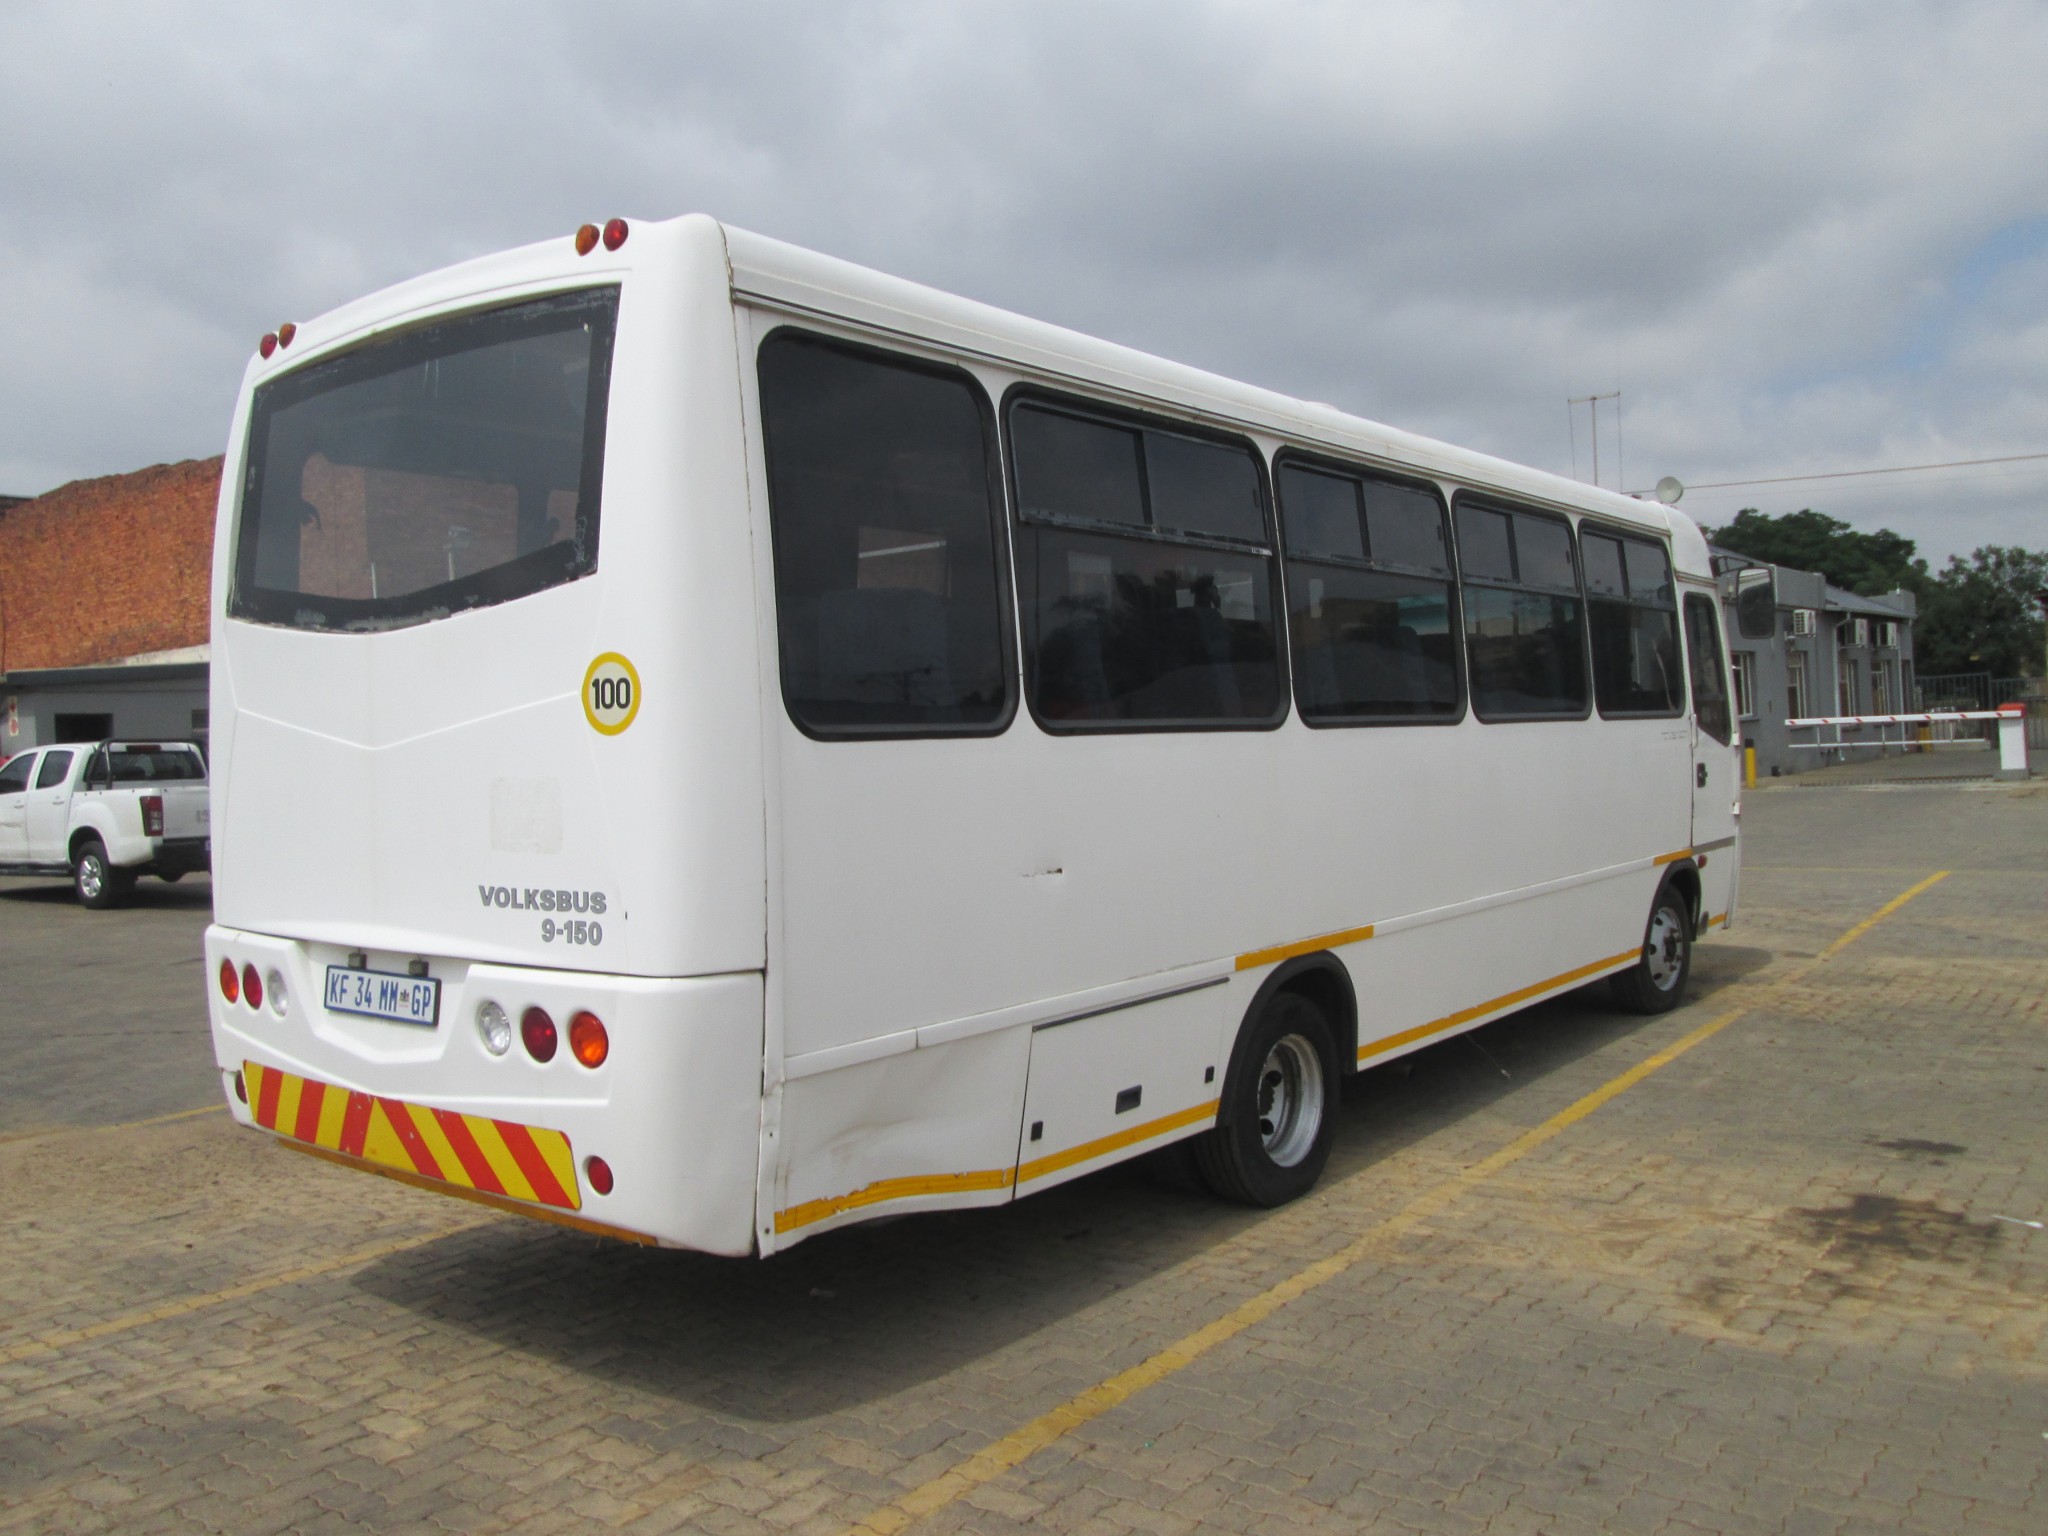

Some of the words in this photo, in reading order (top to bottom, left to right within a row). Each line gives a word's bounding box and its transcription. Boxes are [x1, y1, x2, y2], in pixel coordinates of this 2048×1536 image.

[592, 677, 631, 710] 100
[478, 885, 607, 915] VOLKSBUS
[541, 918, 603, 946] 9-150
[330, 973, 349, 1004] KF
[354, 976, 373, 1009] 34
[379, 980, 399, 1013] MM
[411, 984, 431, 1017] GP
